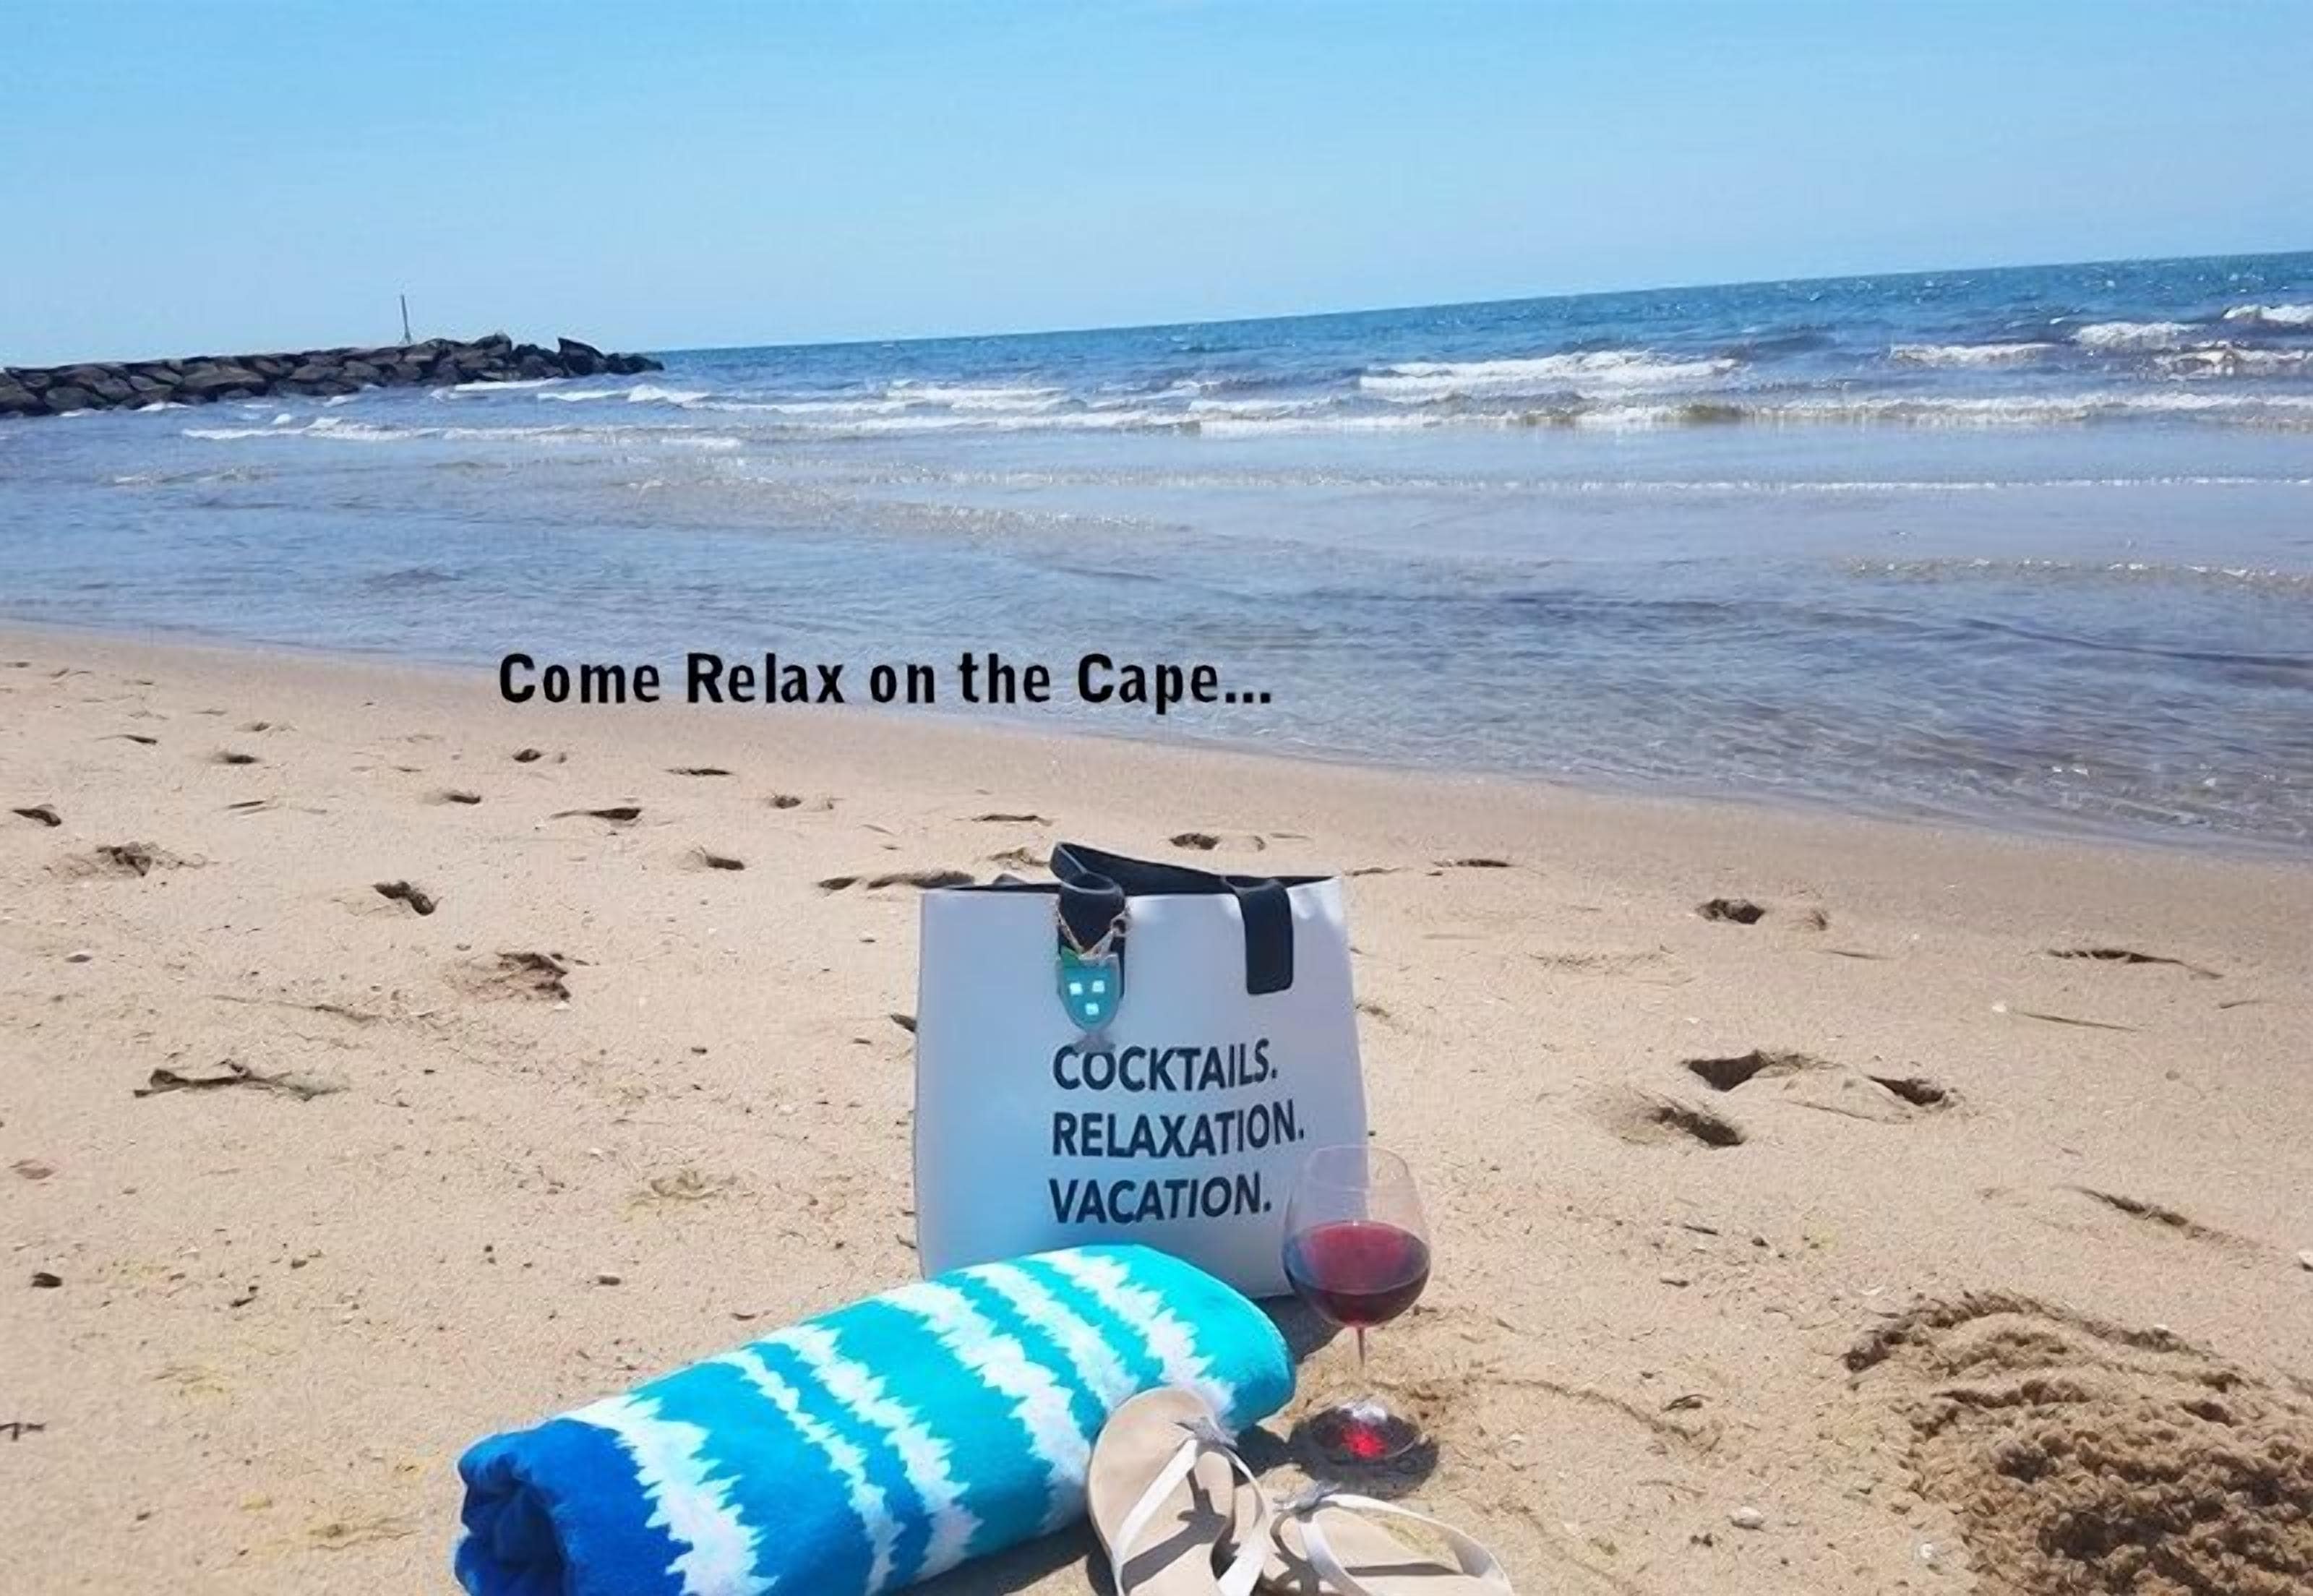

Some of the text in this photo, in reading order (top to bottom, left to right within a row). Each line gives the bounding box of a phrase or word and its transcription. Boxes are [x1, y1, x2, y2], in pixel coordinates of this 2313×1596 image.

[1052, 1038, 1279, 1092] COCKTAILS.
[1052, 1099, 1305, 1159] RELAXATION.
[1049, 1171, 1272, 1224] VACATION.
